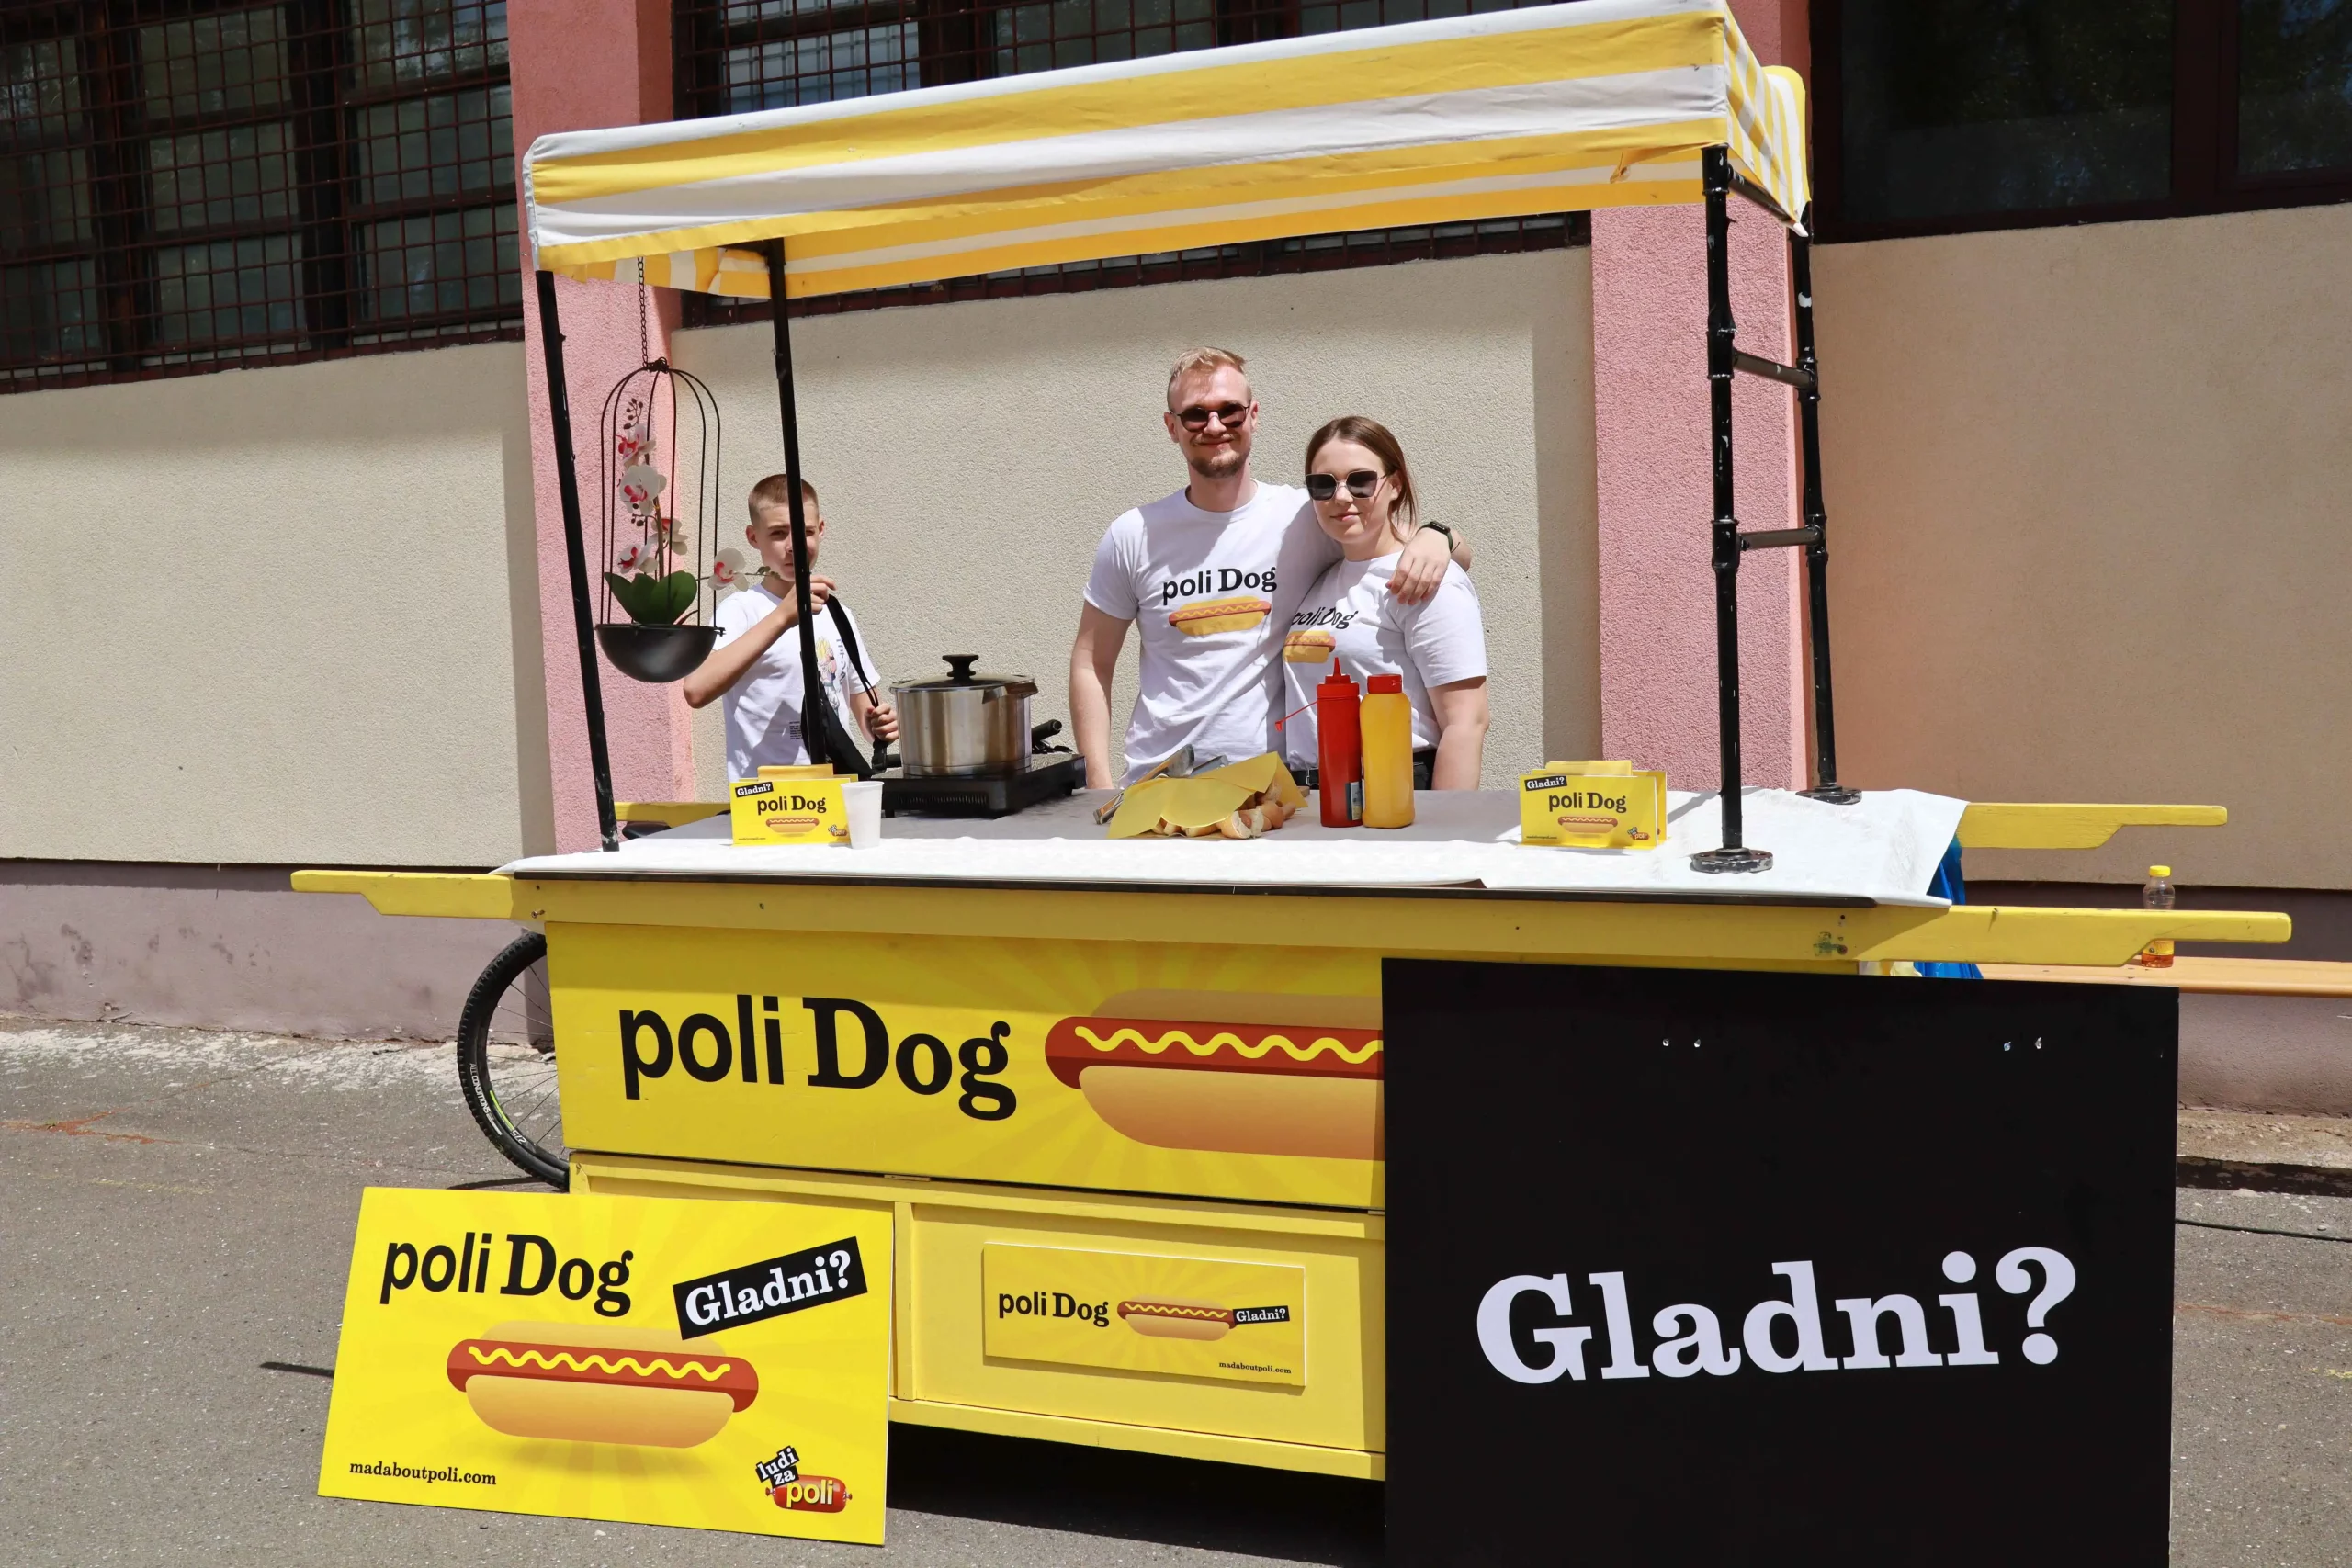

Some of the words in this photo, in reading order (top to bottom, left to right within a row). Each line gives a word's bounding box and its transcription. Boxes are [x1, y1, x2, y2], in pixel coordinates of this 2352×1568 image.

[1162, 570, 1211, 605] poli
[1217, 566, 1278, 593] Dog
[736, 784, 772, 796] Gladni?
[1526, 777, 1565, 789] Gladni?
[757, 796, 787, 816] poli
[791, 795, 827, 813] Dog
[1549, 792, 1582, 812] poli
[1587, 792, 1627, 814] Dog
[619, 994, 784, 1100] poli
[803, 997, 1017, 1121] Dog
[471, 1075, 492, 1114] CONDITIONS
[379, 1231, 492, 1304] poli
[500, 1234, 634, 1317] Dog
[684, 1250, 852, 1326] Gladni?
[999, 1291, 1046, 1318] poli
[1052, 1292, 1110, 1327] Dog
[1236, 1308, 1286, 1322] Gladni?
[1476, 1247, 2076, 1384] Gladni?
[1219, 1361, 1292, 1374] madaboutpoli.com
[349, 1461, 497, 1485] madaboutpoli.com
[757, 1447, 797, 1480] ludi
[774, 1470, 796, 1485] za
[786, 1479, 833, 1508] poli
